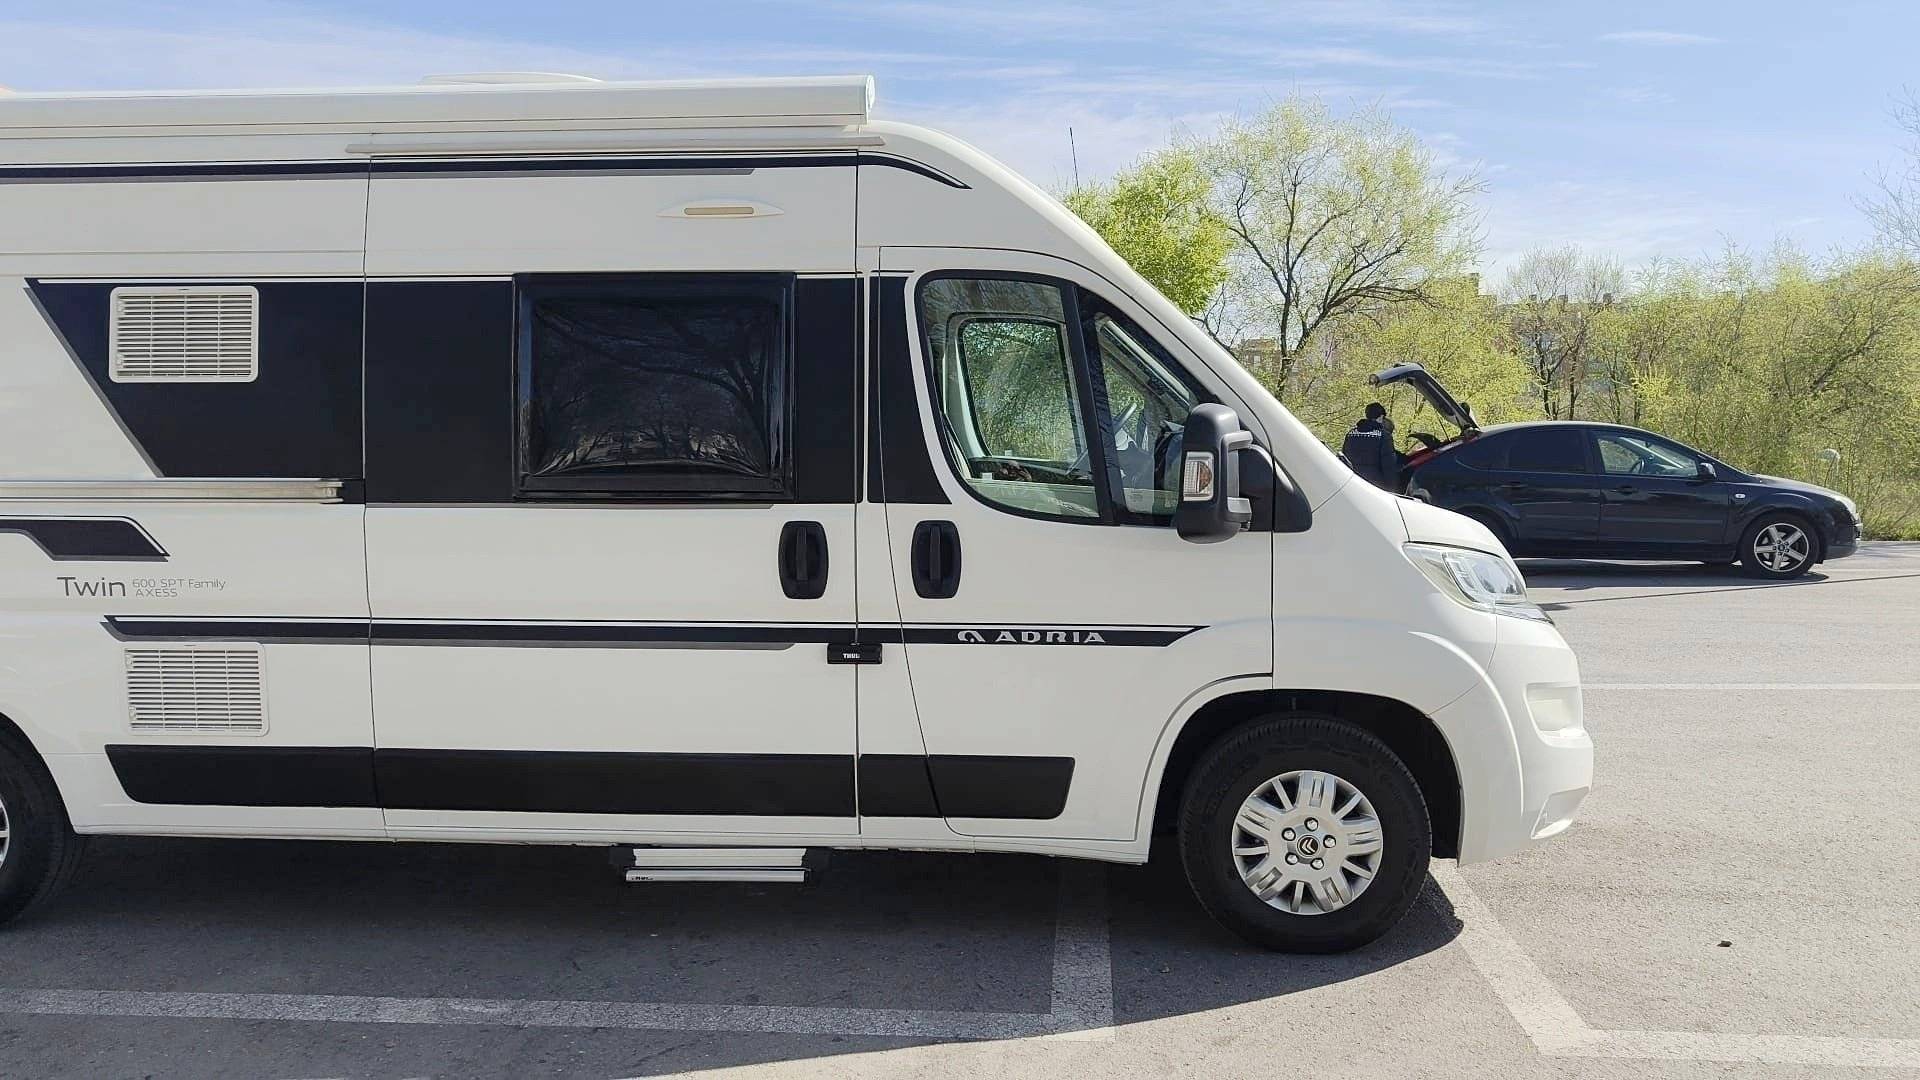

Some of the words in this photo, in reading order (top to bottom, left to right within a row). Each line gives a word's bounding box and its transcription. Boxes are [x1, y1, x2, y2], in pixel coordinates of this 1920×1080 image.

[56, 576, 126, 597] Twin
[132, 578, 156, 588] 600
[160, 578, 185, 588] SPT
[188, 578, 226, 591] Family
[136, 588, 178, 598] AXESS
[995, 630, 1105, 643] ADRIA
